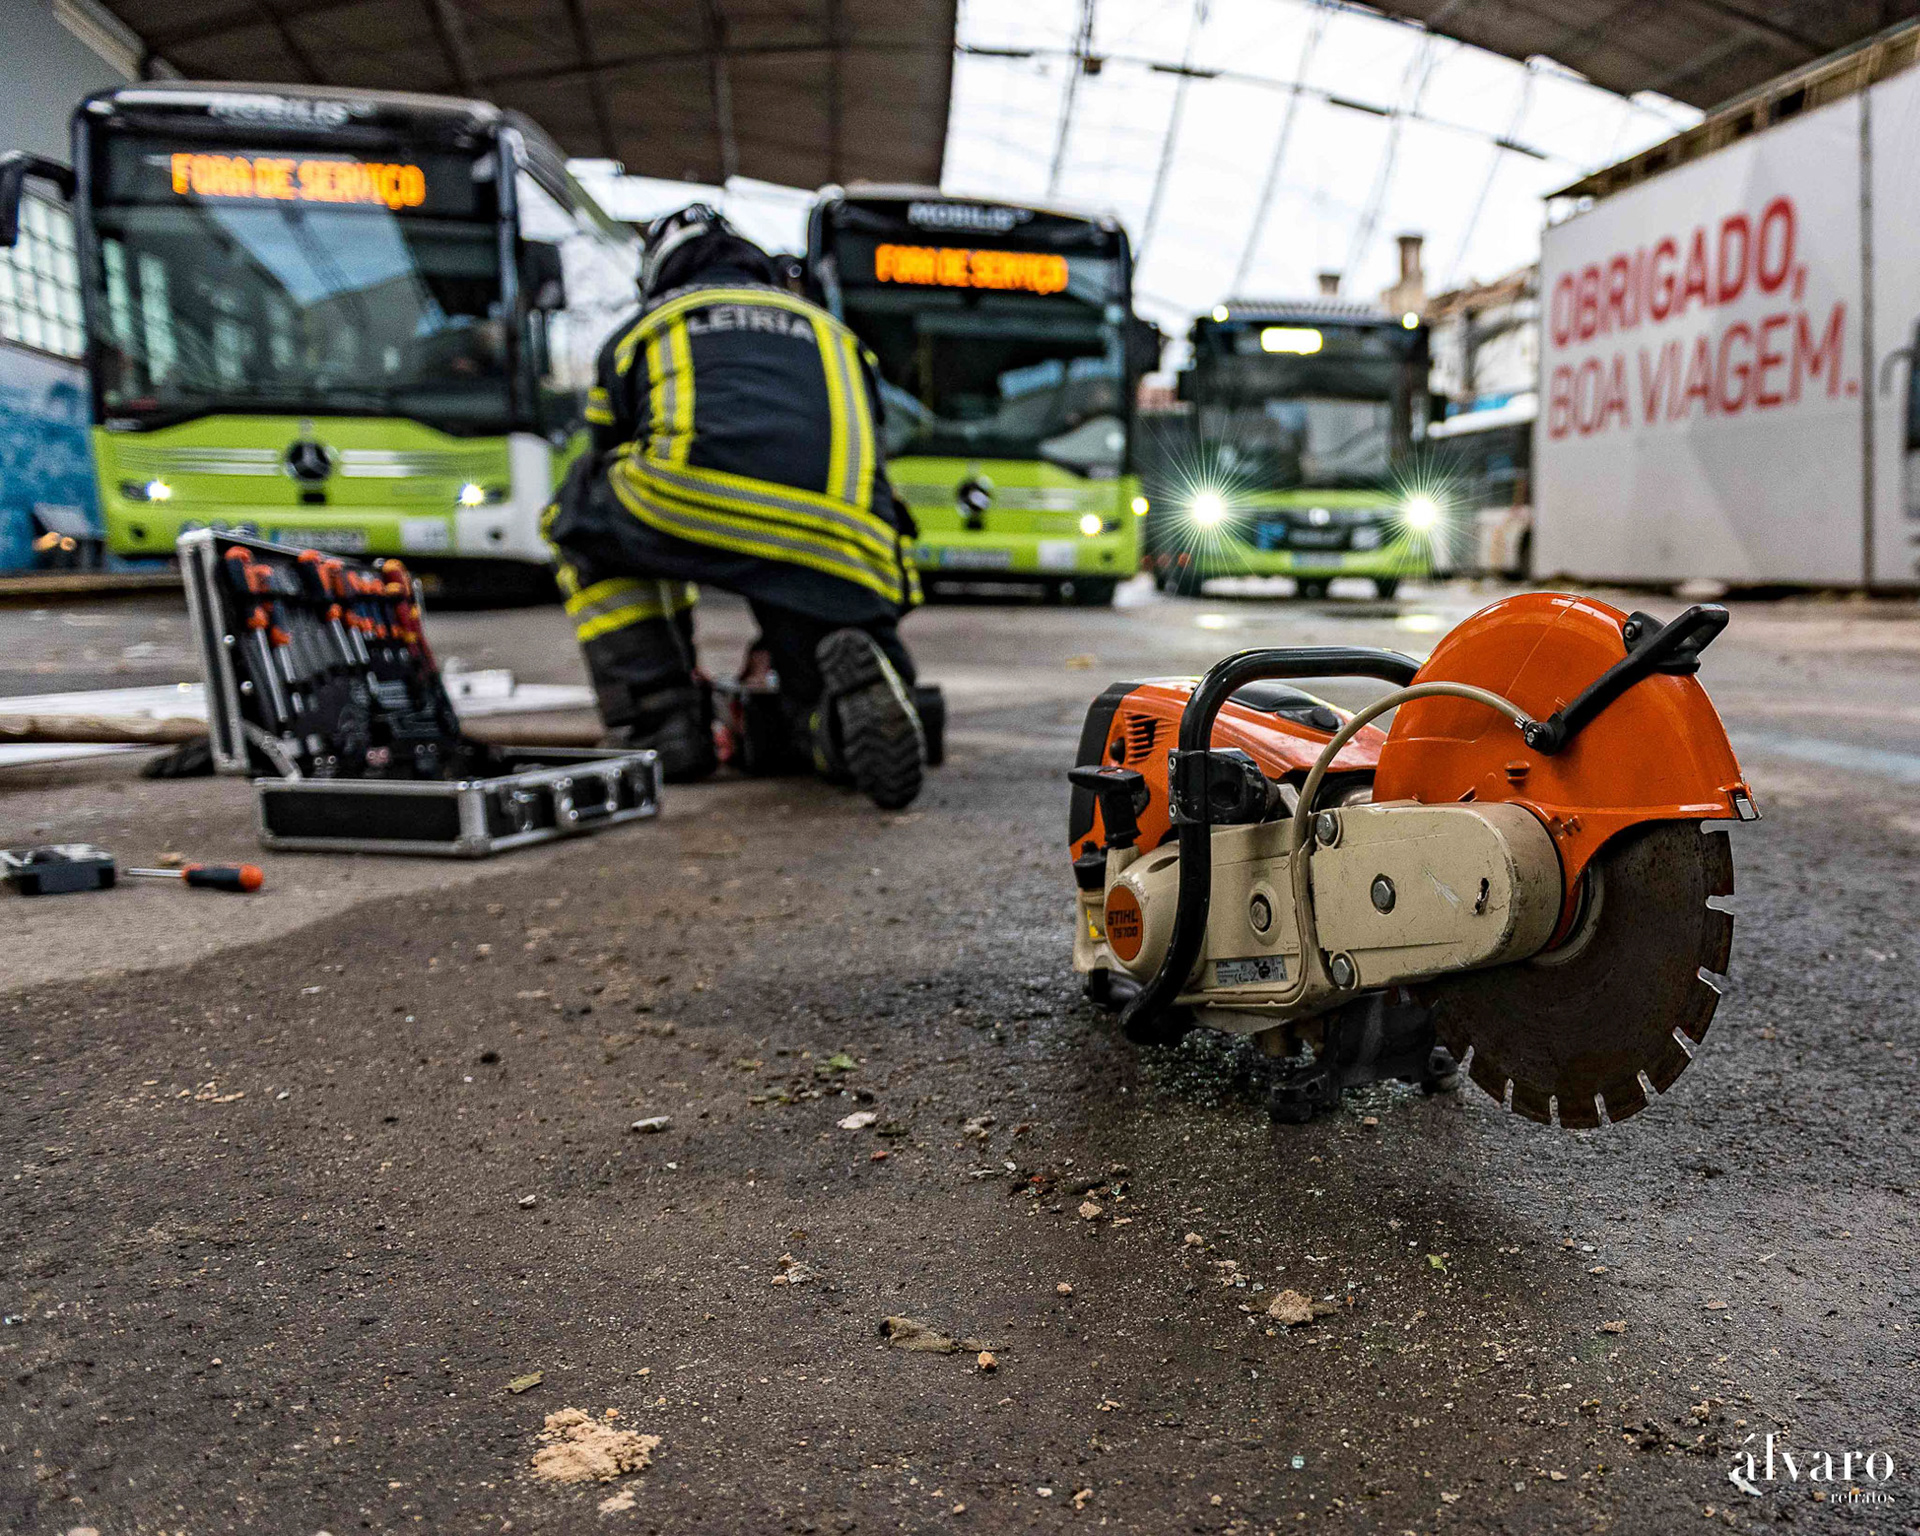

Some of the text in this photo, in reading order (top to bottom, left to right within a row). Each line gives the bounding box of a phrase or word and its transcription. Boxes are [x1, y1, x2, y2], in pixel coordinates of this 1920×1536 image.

[170, 153, 253, 198] FORA
[253, 157, 299, 200] DE
[1549, 194, 1808, 348] OBRIGADO,
[686, 305, 816, 343] LEIRIA
[1548, 300, 1858, 441] BOA VIAGEM.
[1107, 909, 1138, 926] STIHL
